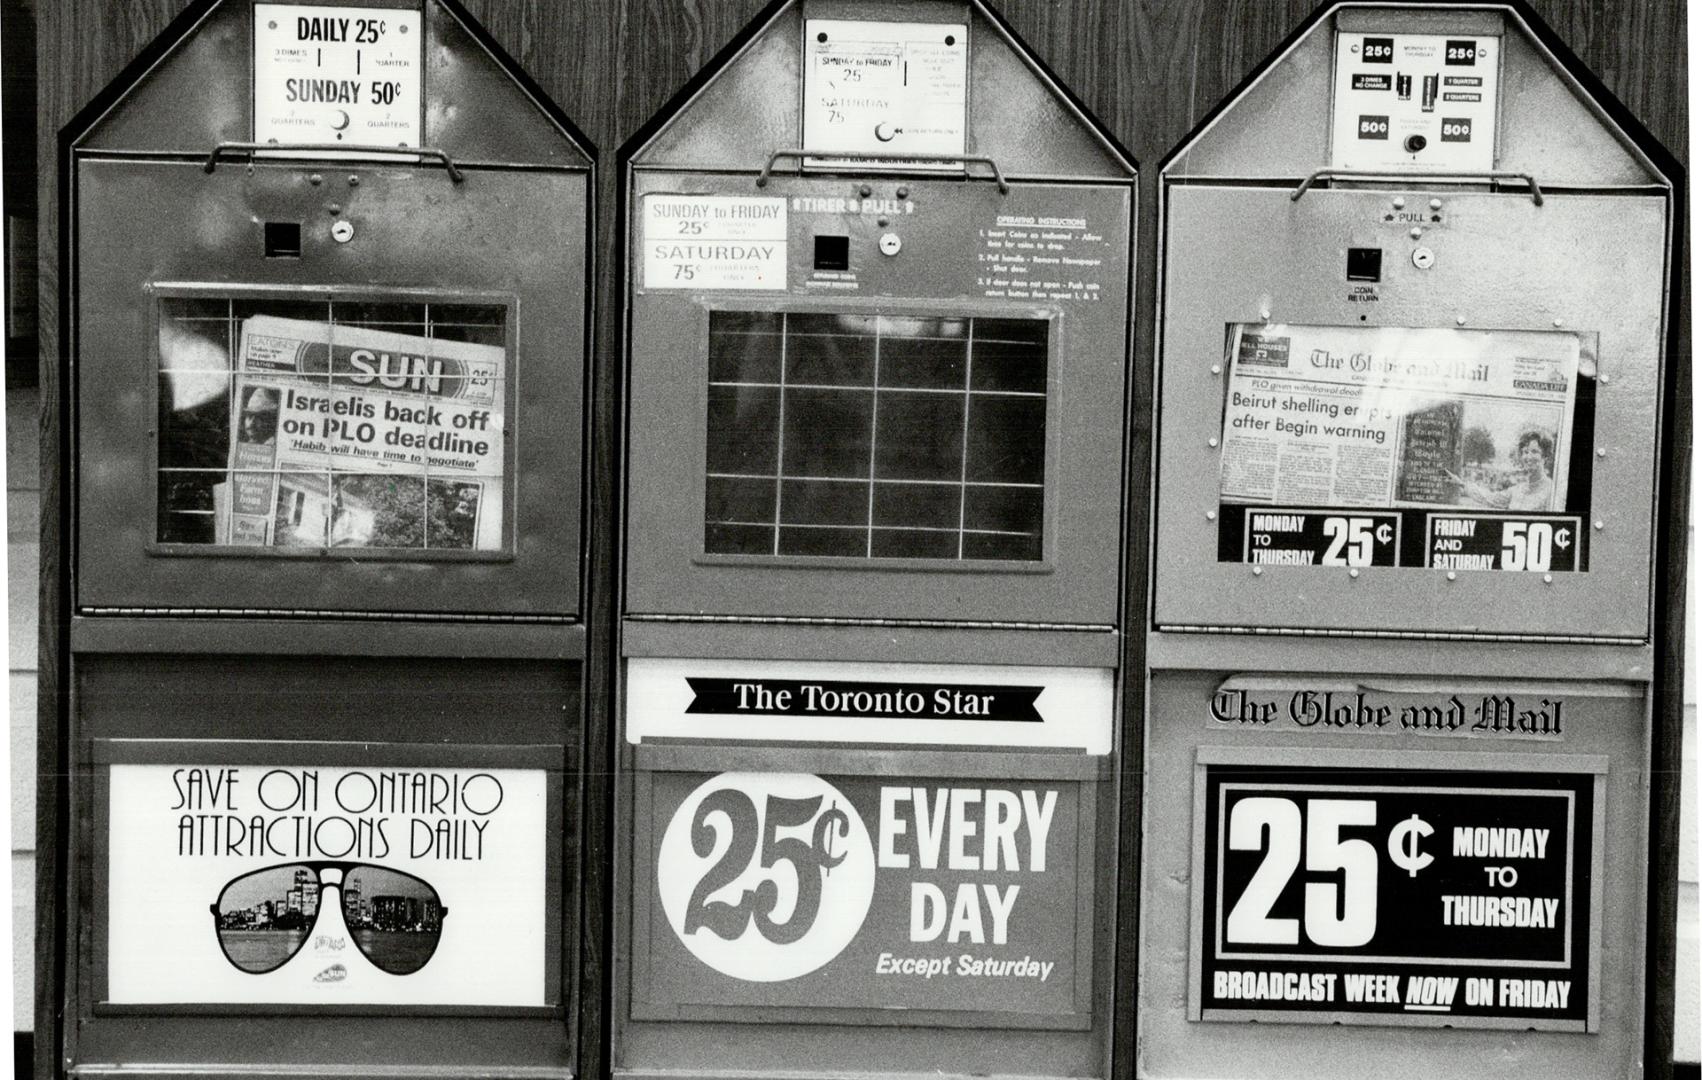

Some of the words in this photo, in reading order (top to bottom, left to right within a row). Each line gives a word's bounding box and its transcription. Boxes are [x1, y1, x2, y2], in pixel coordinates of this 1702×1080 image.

[297, 16, 350, 42] DAILY
[355, 18, 386, 44] 25¢
[1365, 45, 1391, 57] 25¢
[1448, 47, 1474, 59] 25¢
[285, 77, 361, 104] SUNDAY
[371, 81, 401, 105] 50¢
[367, 120, 410, 129] QUARTERS
[1360, 121, 1387, 133] 50¢
[1443, 123, 1470, 135] 50¢
[652, 203, 709, 218] SUNDAY
[714, 207, 727, 219] to
[731, 204, 780, 220] FRIDAY
[802, 198, 846, 213] TIRER
[861, 199, 902, 214] PULL
[678, 221, 709, 235] 25¢
[997, 216, 1035, 225] OPERATING
[1038, 217, 1086, 227] INSTRUCTIONS
[1398, 213, 1426, 222] PULL
[654, 246, 775, 260] SATURDAY
[673, 264, 702, 281] 75¢
[1348, 294, 1379, 302] RETURN
[1354, 286, 1374, 294] COIN
[350, 349, 443, 394] SUN
[1311, 349, 1345, 370] The
[1350, 352, 1399, 373] Glbe
[1251, 379, 1269, 389] PLO
[1270, 382, 1292, 391] given
[1294, 383, 1339, 396] withdrawal
[285, 389, 376, 419] Israelis
[384, 400, 442, 426] back
[452, 410, 490, 431] off
[1232, 391, 1276, 410] Beirut
[1281, 396, 1348, 418] shelling
[282, 419, 315, 437] on
[322, 418, 376, 444] PLO
[384, 427, 489, 457] deadline
[1232, 415, 1270, 431] after
[1275, 418, 1318, 437] Begin
[1323, 424, 1387, 444] warning
[330, 442, 350, 455] will
[353, 444, 379, 458] have
[383, 449, 406, 462] time
[410, 452, 421, 463] to
[1252, 514, 1306, 533] MONDAY
[1321, 517, 1393, 568] 25¢
[1253, 534, 1271, 546] TO
[1434, 539, 1463, 551] AND
[1434, 519, 1477, 537] FRIDAY
[1501, 521, 1572, 572] 50¢
[1252, 549, 1315, 566] THURSDAY
[1433, 553, 1495, 571] SATURDAY
[733, 683, 793, 711] The
[800, 685, 925, 714] Toronto
[933, 687, 995, 716] Star
[1208, 687, 1278, 726] The
[1287, 689, 1392, 729] Globe
[1400, 695, 1466, 732] and
[1472, 694, 1564, 736] Mail
[171, 768, 239, 811] SAVE
[258, 769, 318, 812] ON
[335, 771, 503, 816] ONTARIO
[178, 814, 390, 859] ATTRACTIONS
[410, 818, 491, 860] DAILY
[877, 786, 1059, 872] EVERY
[1453, 826, 1551, 859] MONDAY
[683, 787, 851, 945] 25¢
[1226, 796, 1435, 948] 25¢
[1484, 866, 1518, 888] TO
[909, 881, 1021, 945] DAY
[1441, 895, 1559, 929] THURSDAY
[875, 952, 951, 979] Except
[956, 954, 1055, 981] Saturday
[1213, 970, 1338, 1002] BROADCAST
[1344, 974, 1400, 1003] WEEK
[1405, 976, 1460, 1005] NOW
[1465, 977, 1494, 1007] ON
[1498, 979, 1572, 1010] FRIDAY
